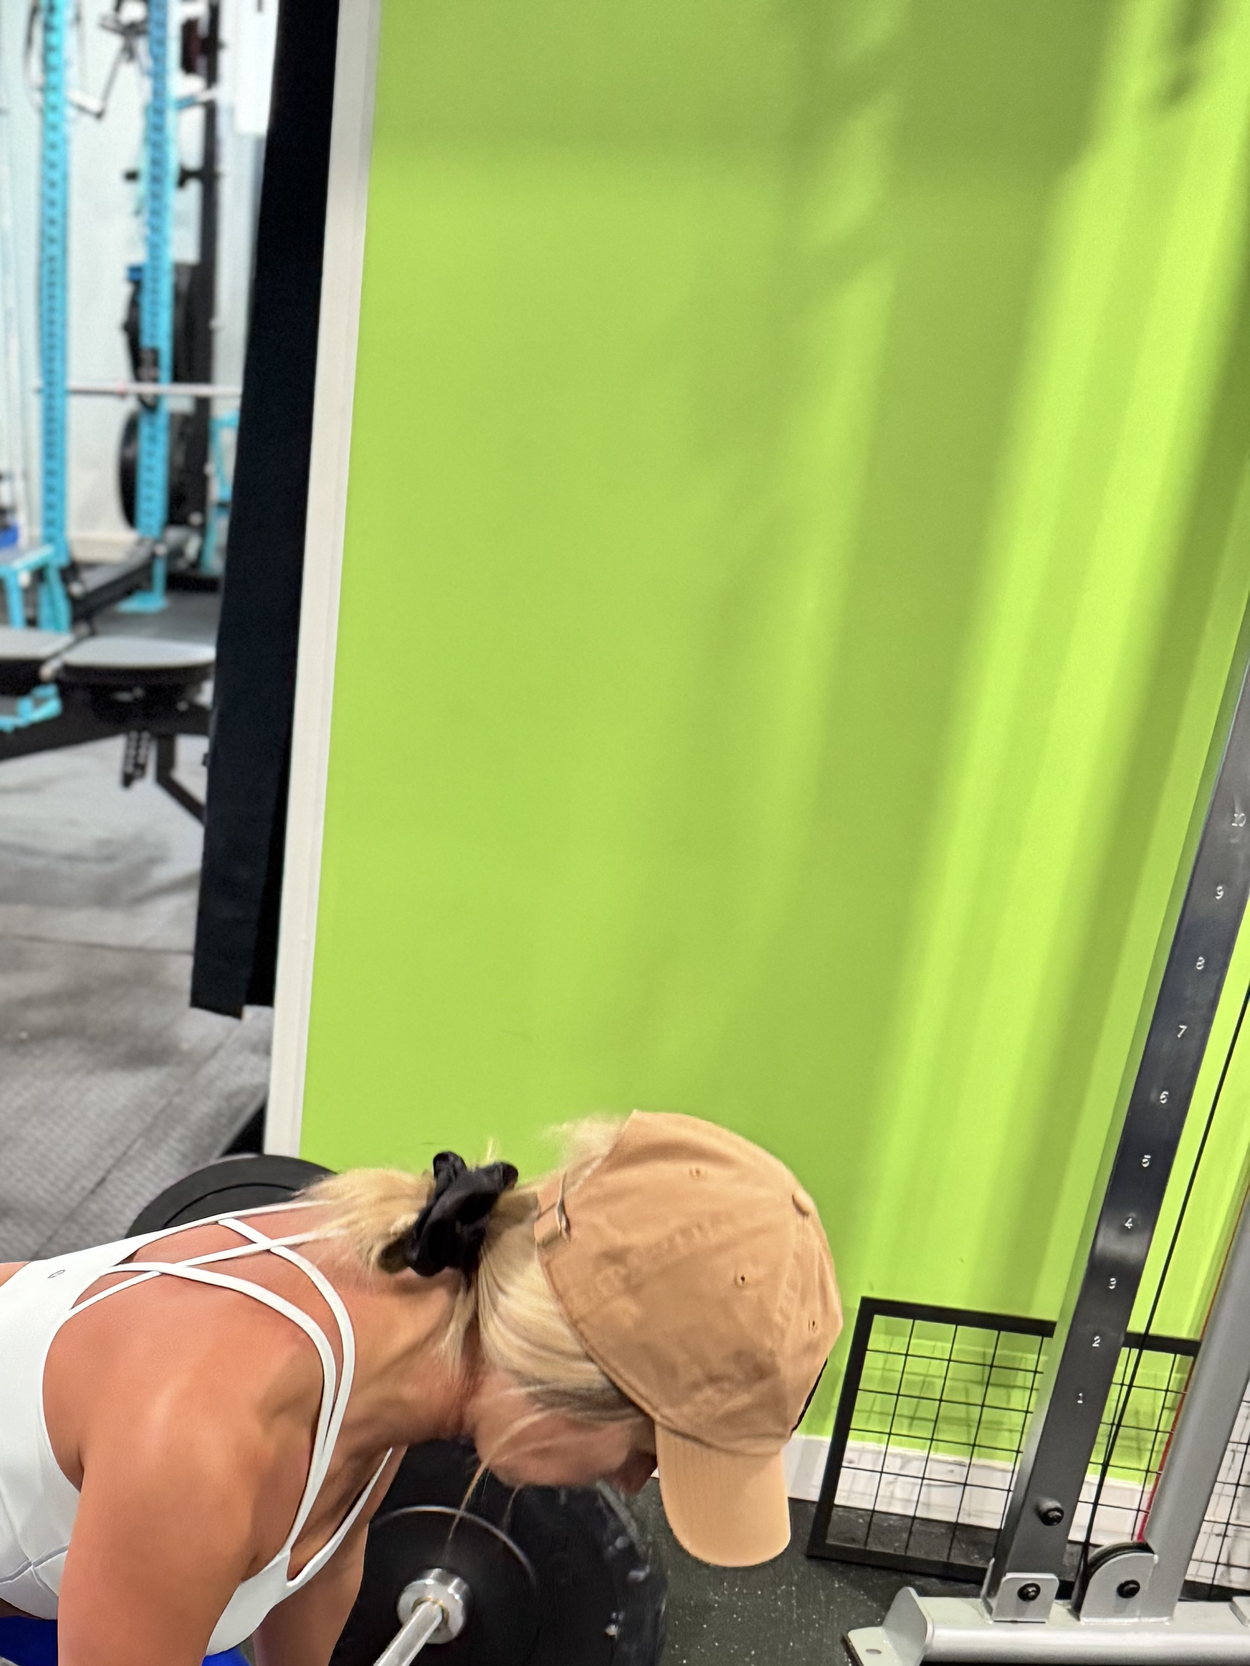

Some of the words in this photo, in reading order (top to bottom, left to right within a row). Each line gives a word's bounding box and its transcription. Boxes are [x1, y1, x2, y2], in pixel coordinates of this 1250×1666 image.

[1231, 812, 1247, 828] 10
[1215, 885, 1225, 900] 9
[1196, 956, 1206, 970] 8
[1176, 1024, 1187, 1039] 7
[1159, 1090, 1169, 1104] 6
[1141, 1154, 1152, 1168] 5
[1124, 1217, 1134, 1230] 4
[1108, 1277, 1117, 1289] 3
[1091, 1335, 1101, 1347] 2
[1076, 1392, 1084, 1404] 1
